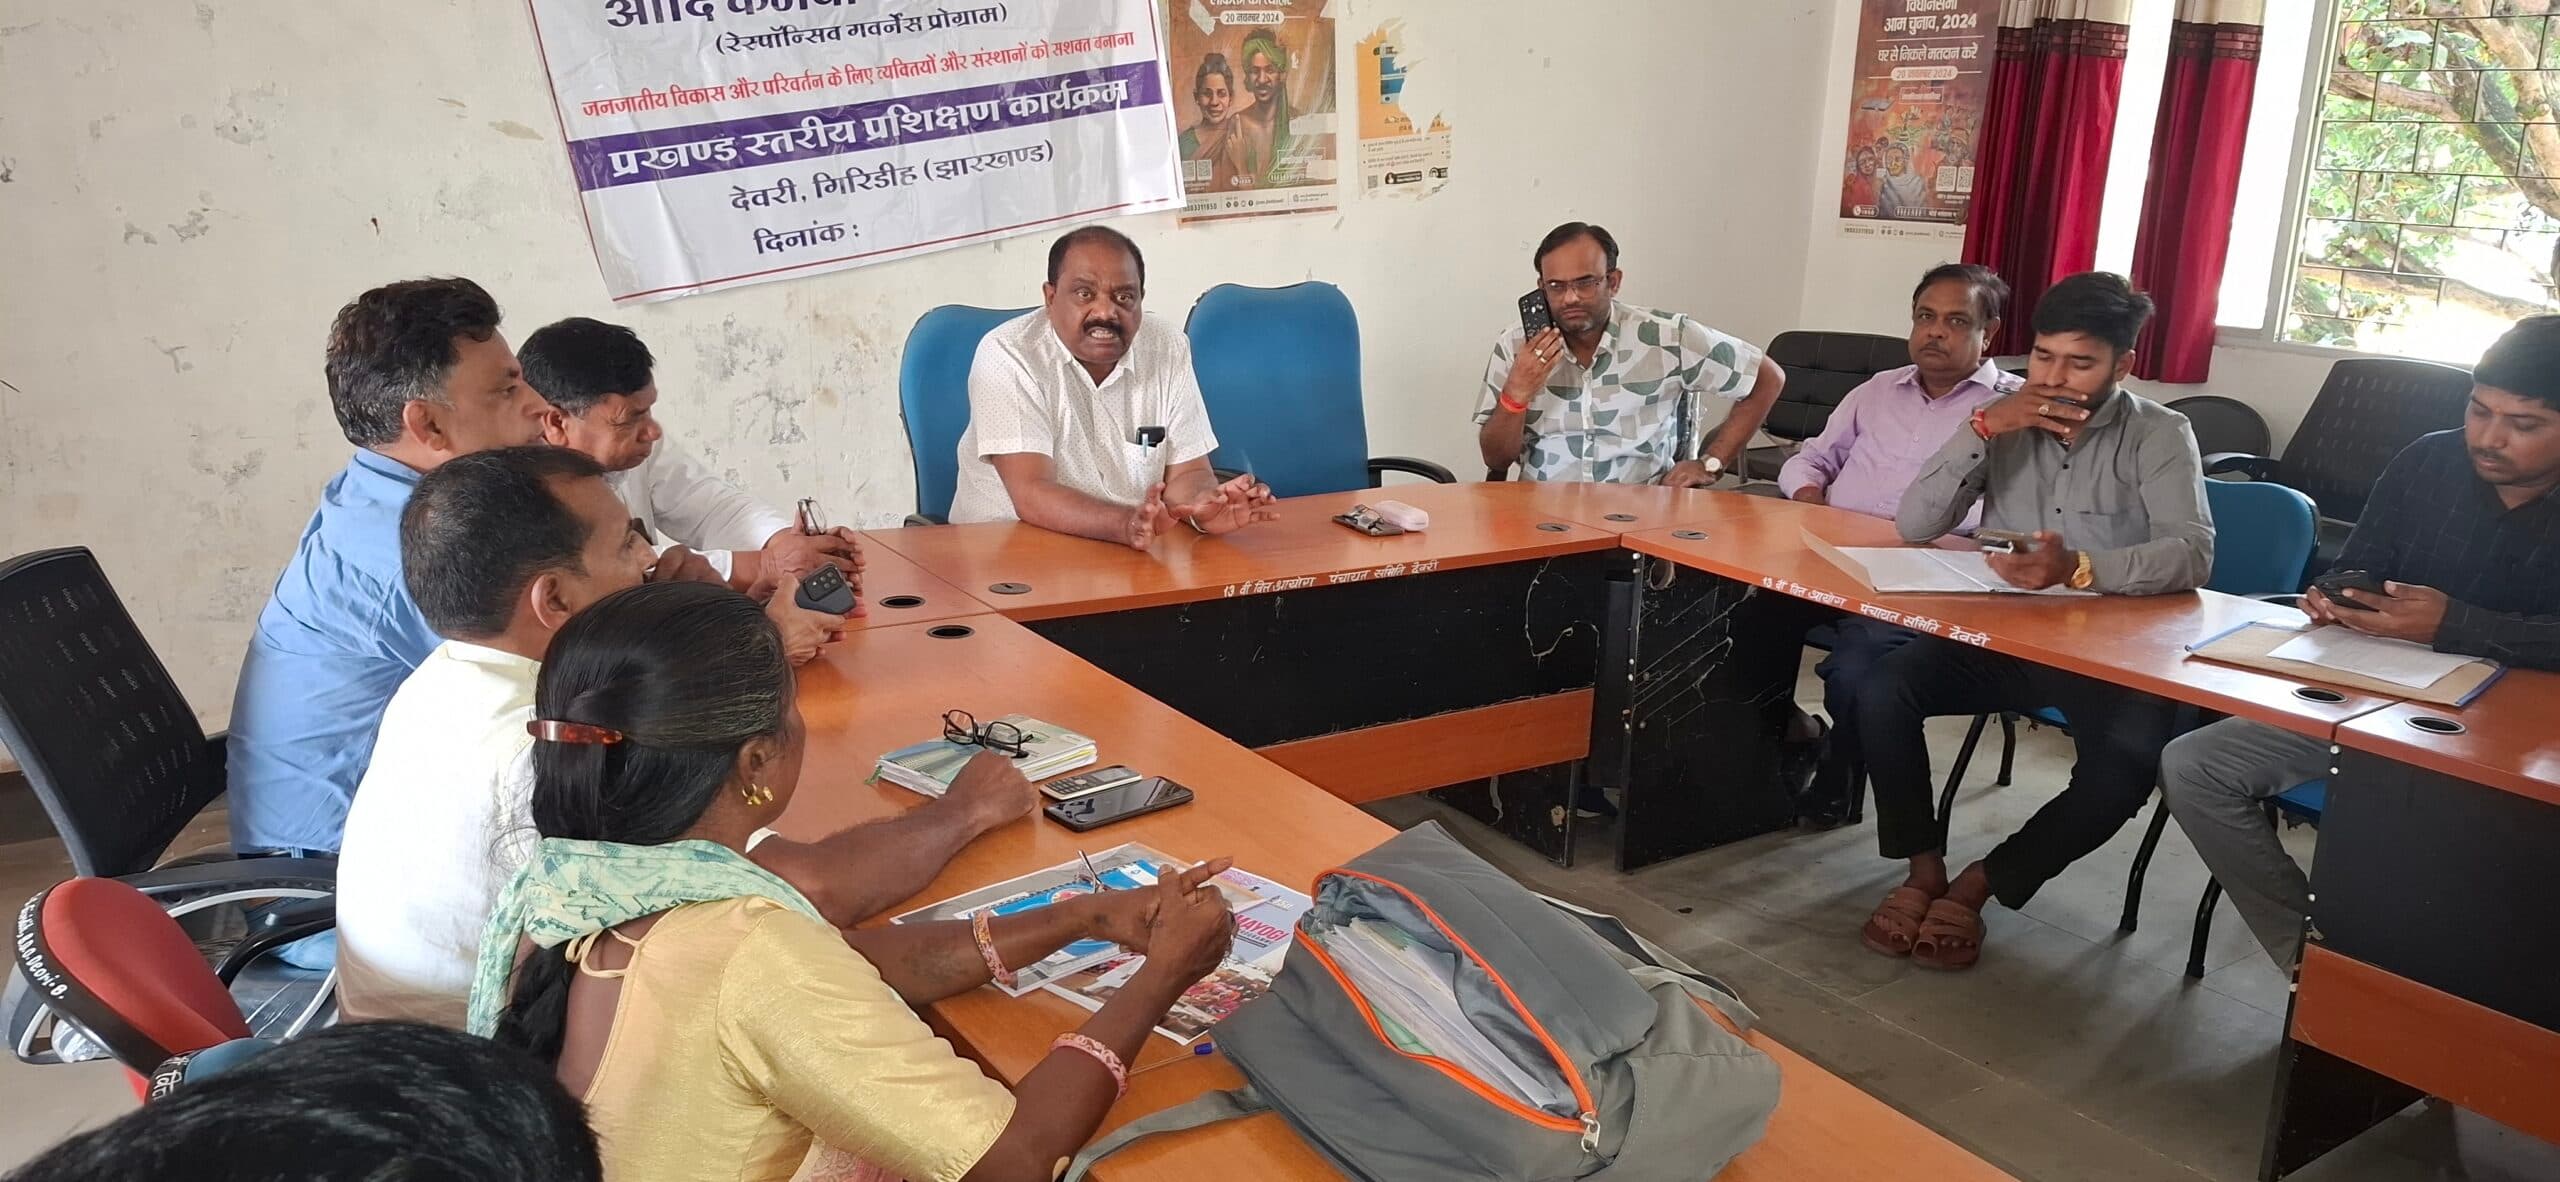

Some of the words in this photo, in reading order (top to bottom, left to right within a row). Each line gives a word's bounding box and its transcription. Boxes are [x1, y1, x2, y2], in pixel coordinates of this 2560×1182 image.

[927, 3, 1007, 30] प्रोग्राम)
[1884, 17, 1907, 32] आम
[1909, 15, 1939, 35] चुनाव,
[1942, 14, 1977, 29] 2024
[582, 87, 669, 118] जनजातीय
[669, 83, 726, 109] विकास
[730, 77, 761, 101] और
[764, 69, 825, 96] परिवर्तन
[827, 66, 843, 87] के
[845, 63, 874, 85] लिए
[940, 50, 968, 72] और
[1030, 39, 1049, 60] को
[608, 137, 738, 178] प्रखण्ड
[741, 113, 857, 156] स्तरीय
[862, 103, 1001, 141] प्रशिक्षण
[1006, 79, 1129, 118] कार्यक्रम
[729, 177, 807, 211] देवरी,
[812, 161, 918, 199] गिरिडीह
[923, 139, 1054, 181] (झारखण्ड)
[753, 220, 846, 254] दिनांक
